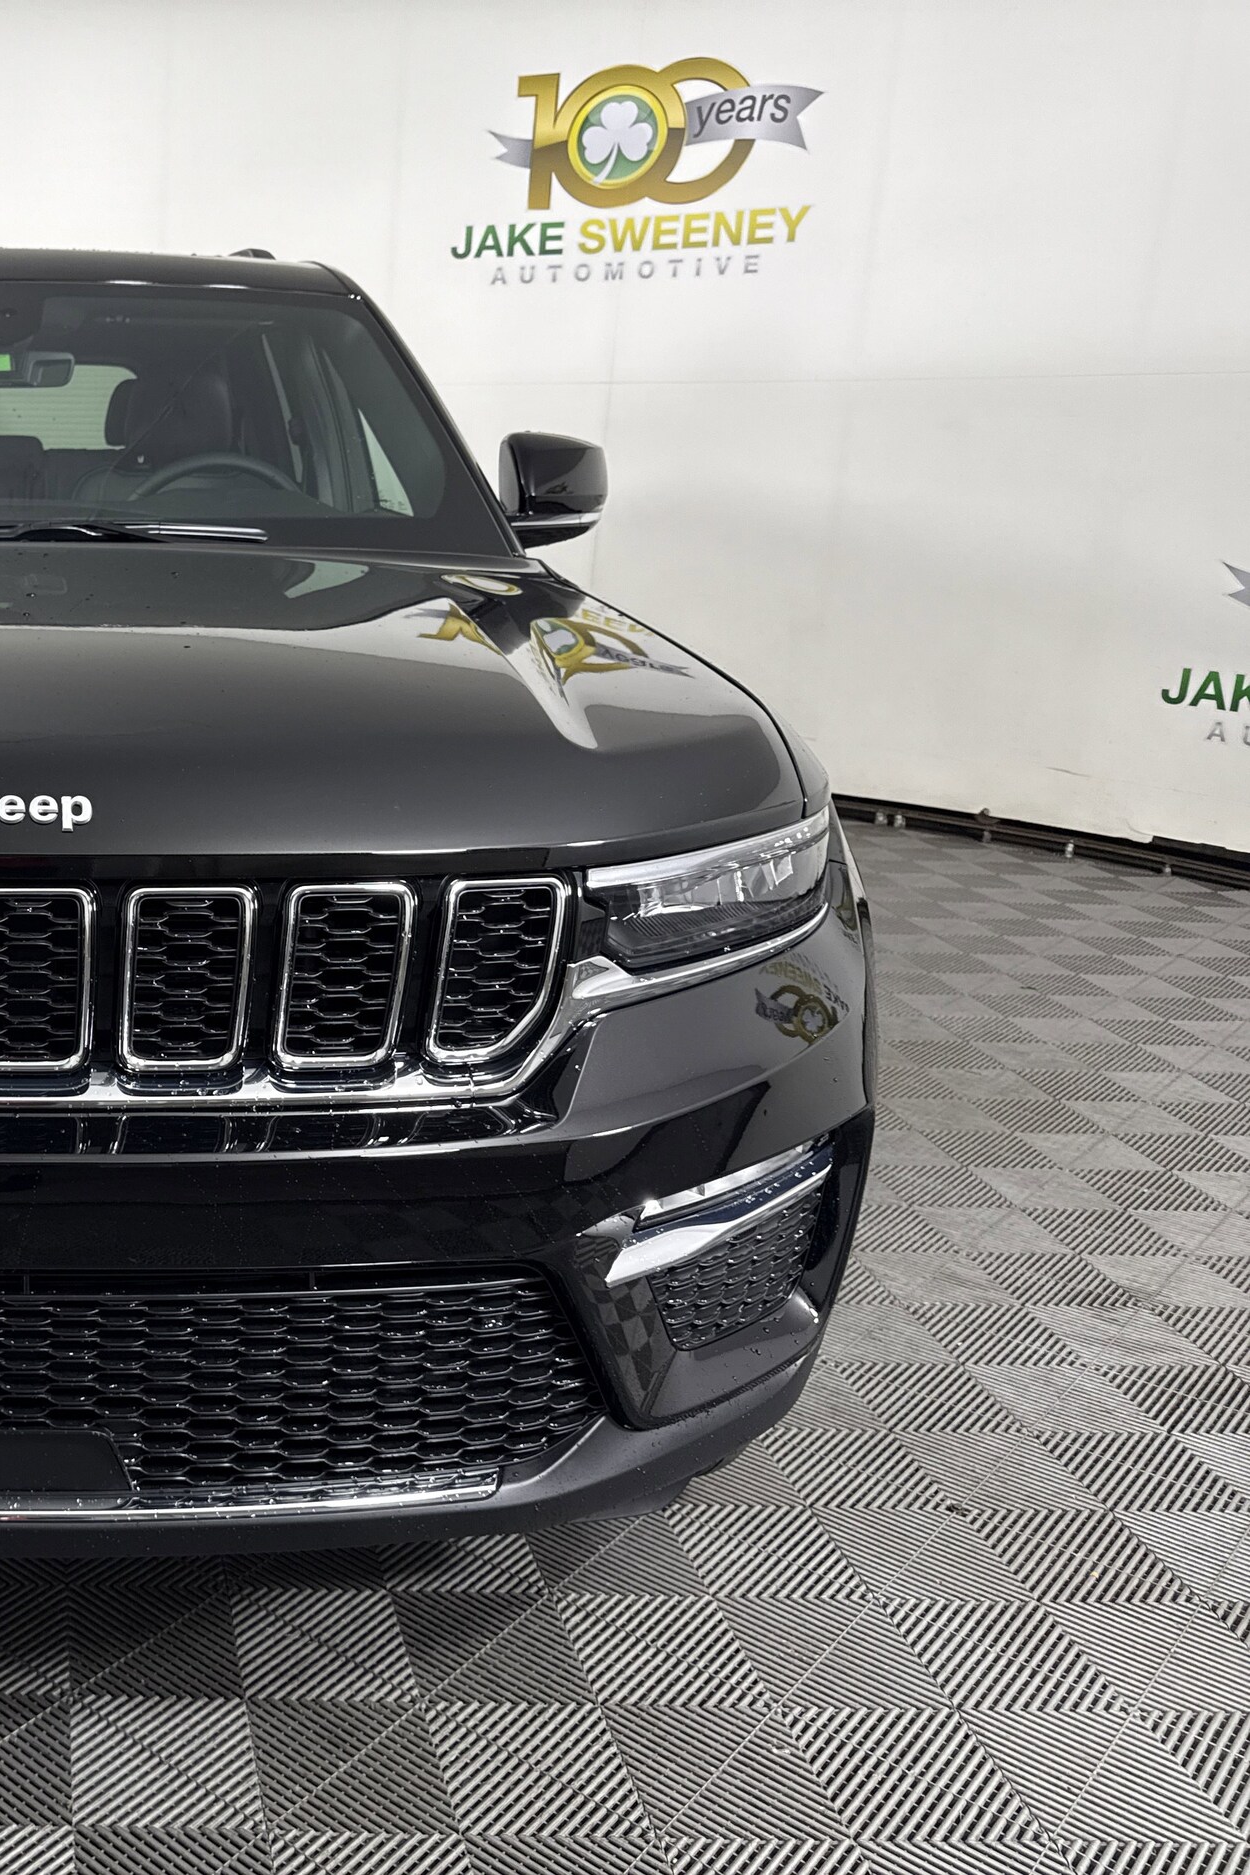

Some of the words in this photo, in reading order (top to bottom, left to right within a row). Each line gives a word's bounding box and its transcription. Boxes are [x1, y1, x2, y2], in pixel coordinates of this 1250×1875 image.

[518, 56, 757, 210] 100
[691, 92, 792, 139] years
[450, 220, 565, 260] JAKE
[578, 204, 812, 255] SWEENEY
[490, 254, 761, 286] AUTOMOTIVE
